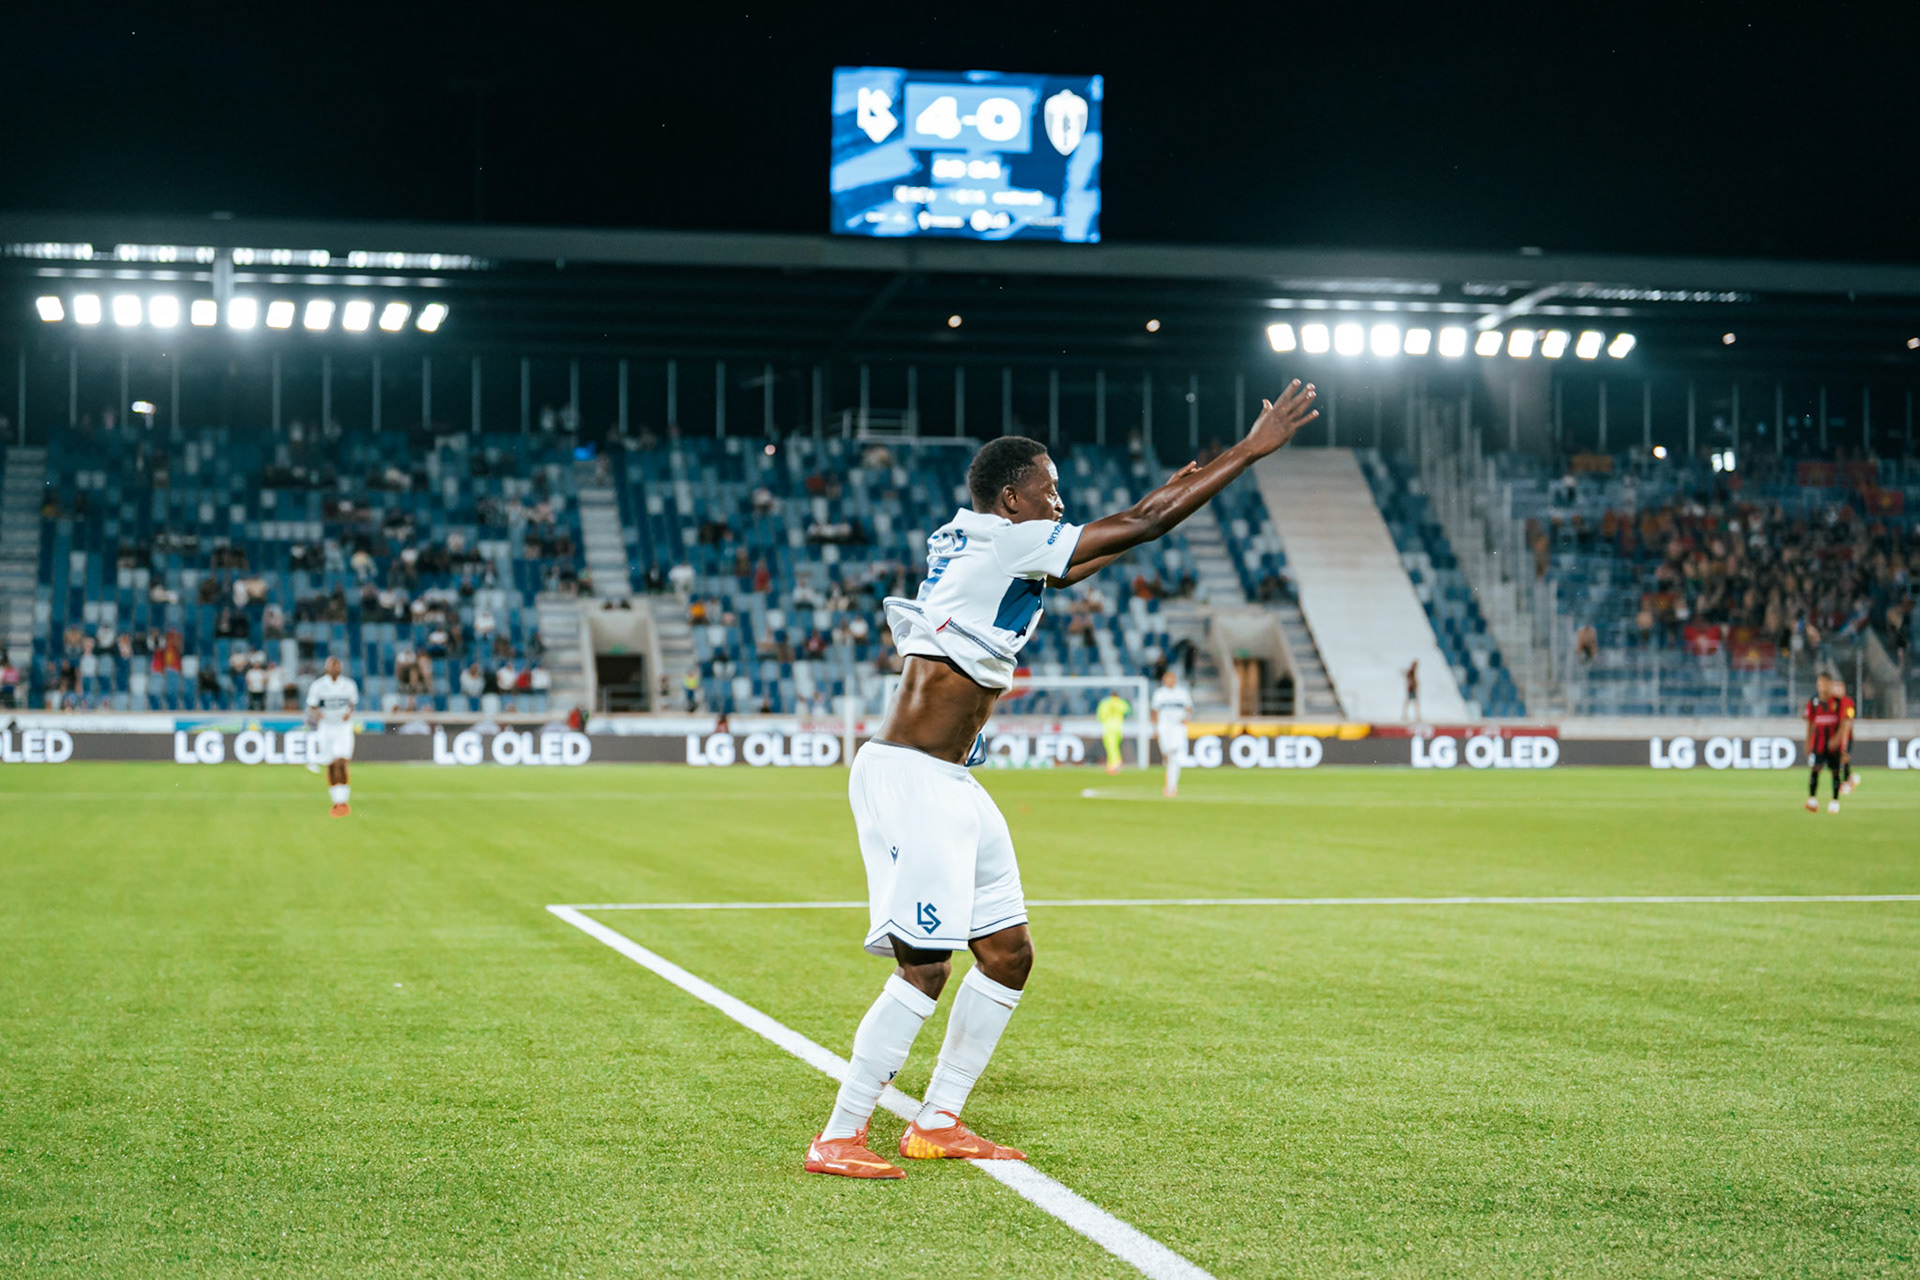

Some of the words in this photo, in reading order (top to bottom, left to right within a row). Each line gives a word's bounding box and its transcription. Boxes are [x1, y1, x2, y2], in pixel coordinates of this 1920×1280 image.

[916, 96, 1022, 142] 4-0
[0, 729, 73, 763] LED
[174, 730, 225, 764] LG
[433, 731, 484, 765] LG
[492, 731, 591, 765] OLED
[686, 733, 735, 767] LG
[743, 733, 840, 767] OLED
[1230, 735, 1323, 768] OLED
[1411, 735, 1458, 768] LG
[1465, 735, 1559, 768] OLED
[1650, 737, 1696, 769] LG
[1704, 737, 1797, 769] OLED
